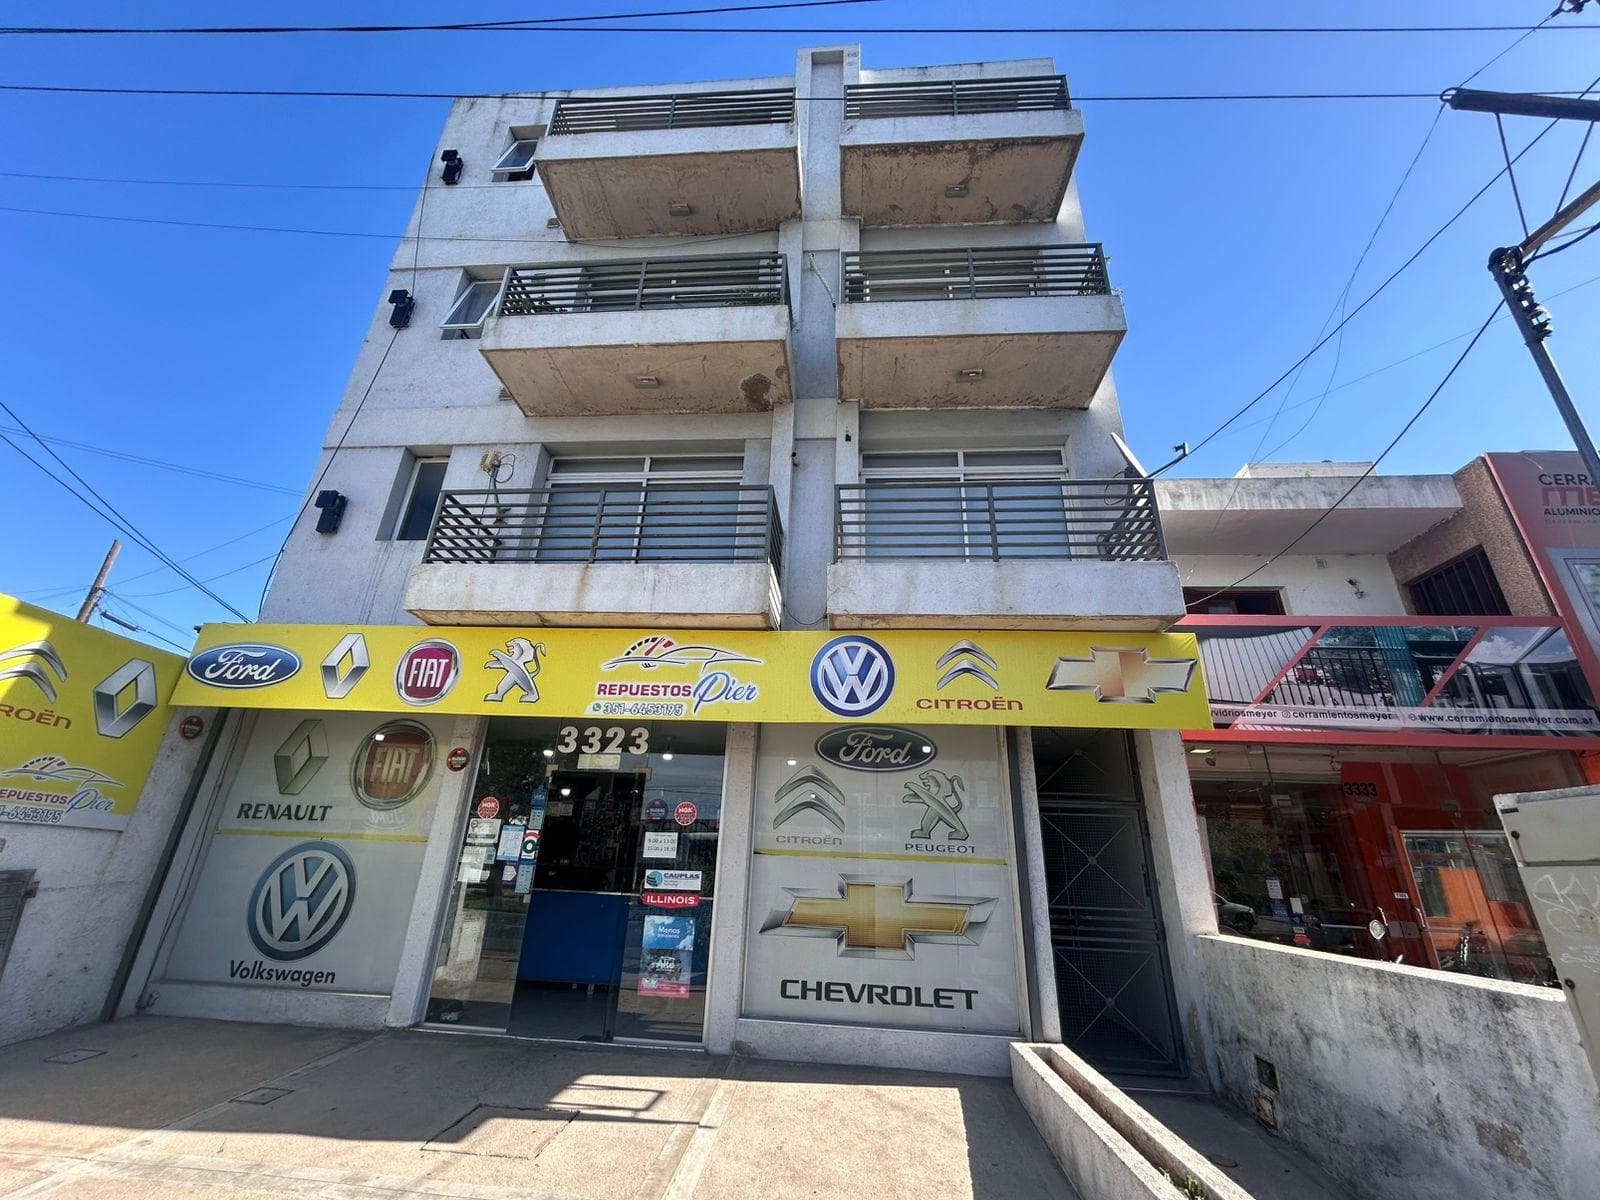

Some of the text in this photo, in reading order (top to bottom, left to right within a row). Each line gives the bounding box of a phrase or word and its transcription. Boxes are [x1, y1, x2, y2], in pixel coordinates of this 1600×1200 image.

[1538, 473, 1594, 486] CERR
[209, 649, 283, 682] Ford
[407, 658, 450, 688] FIAT
[597, 672, 758, 714] REPUESTOS Pier
[603, 702, 684, 716] 351-6453195
[1418, 714, 1594, 725] www.cerramientosmeyer.com.ar
[557, 726, 650, 755] 3323
[839, 731, 913, 764] Ford
[369, 747, 421, 784] FIAT
[0, 788, 114, 814] EPUESTOS Pier
[1343, 782, 1377, 796] 3333
[236, 803, 333, 822] RENAULT
[905, 843, 976, 854] PEUGEOT
[663, 872, 700, 880] CAUPLAS
[646, 895, 695, 905] ILLINOIS
[229, 959, 336, 987] Volkswagen
[780, 979, 979, 1010] CHEVROLET
